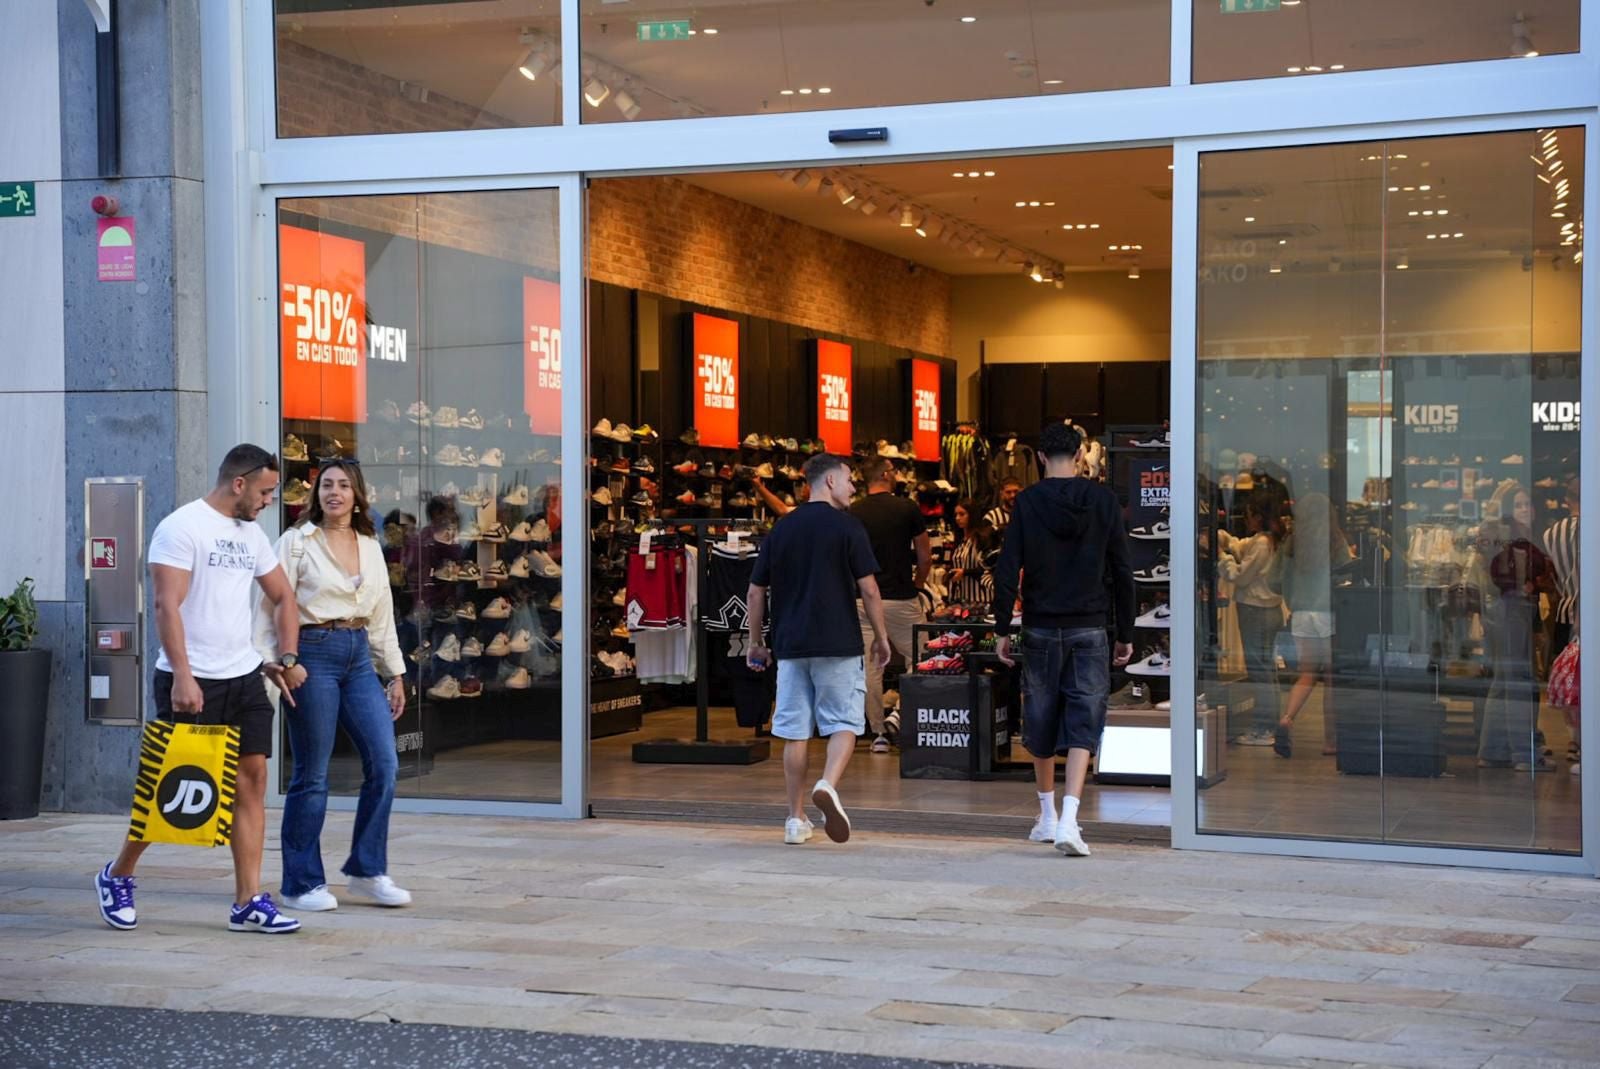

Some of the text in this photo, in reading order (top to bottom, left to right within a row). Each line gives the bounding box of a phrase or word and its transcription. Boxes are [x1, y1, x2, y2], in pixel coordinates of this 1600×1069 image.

[284, 285, 357, 346] -50%
[297, 340, 358, 367] EN CASI TODO
[371, 324, 406, 362] MEN
[530, 326, 561, 372] -50
[539, 370, 561, 390] EN CAS
[698, 354, 735, 396] -50%
[1404, 404, 1459, 425] KIDS
[1141, 487, 1170, 498] EXTR
[917, 708, 971, 724] BLACK
[917, 732, 971, 748] FRIDAY
[162, 779, 213, 815] JD
